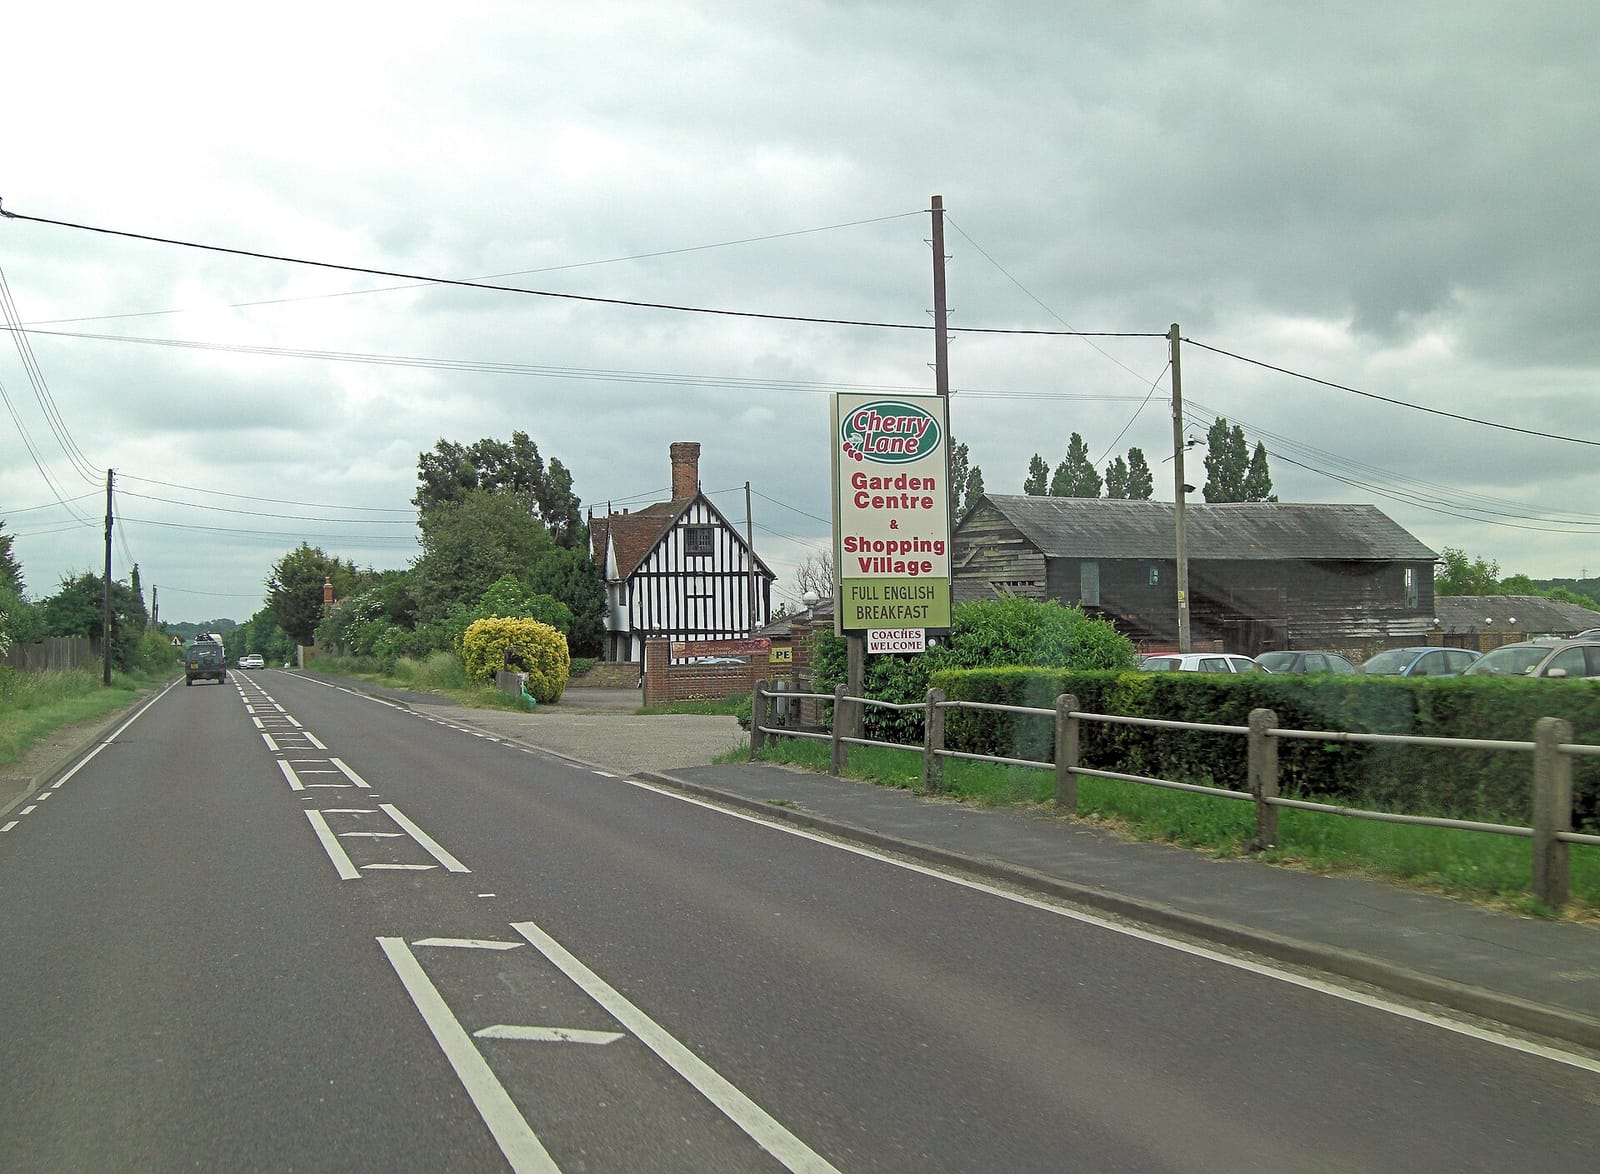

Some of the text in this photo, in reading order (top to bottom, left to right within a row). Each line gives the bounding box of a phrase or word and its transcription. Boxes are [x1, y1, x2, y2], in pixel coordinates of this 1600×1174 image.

[853, 410, 931, 438] Cherry
[863, 432, 919, 454] Lane
[851, 472, 935, 490] Garden
[854, 491, 933, 509] Centre
[889, 519, 899, 529] &
[843, 536, 945, 555] Shopping
[858, 557, 932, 576] Village
[852, 586, 934, 600] FULL ENGLISH
[856, 605, 928, 620] BREAKFAST
[871, 630, 921, 640] COACHES
[870, 641, 923, 650] WELCOME
